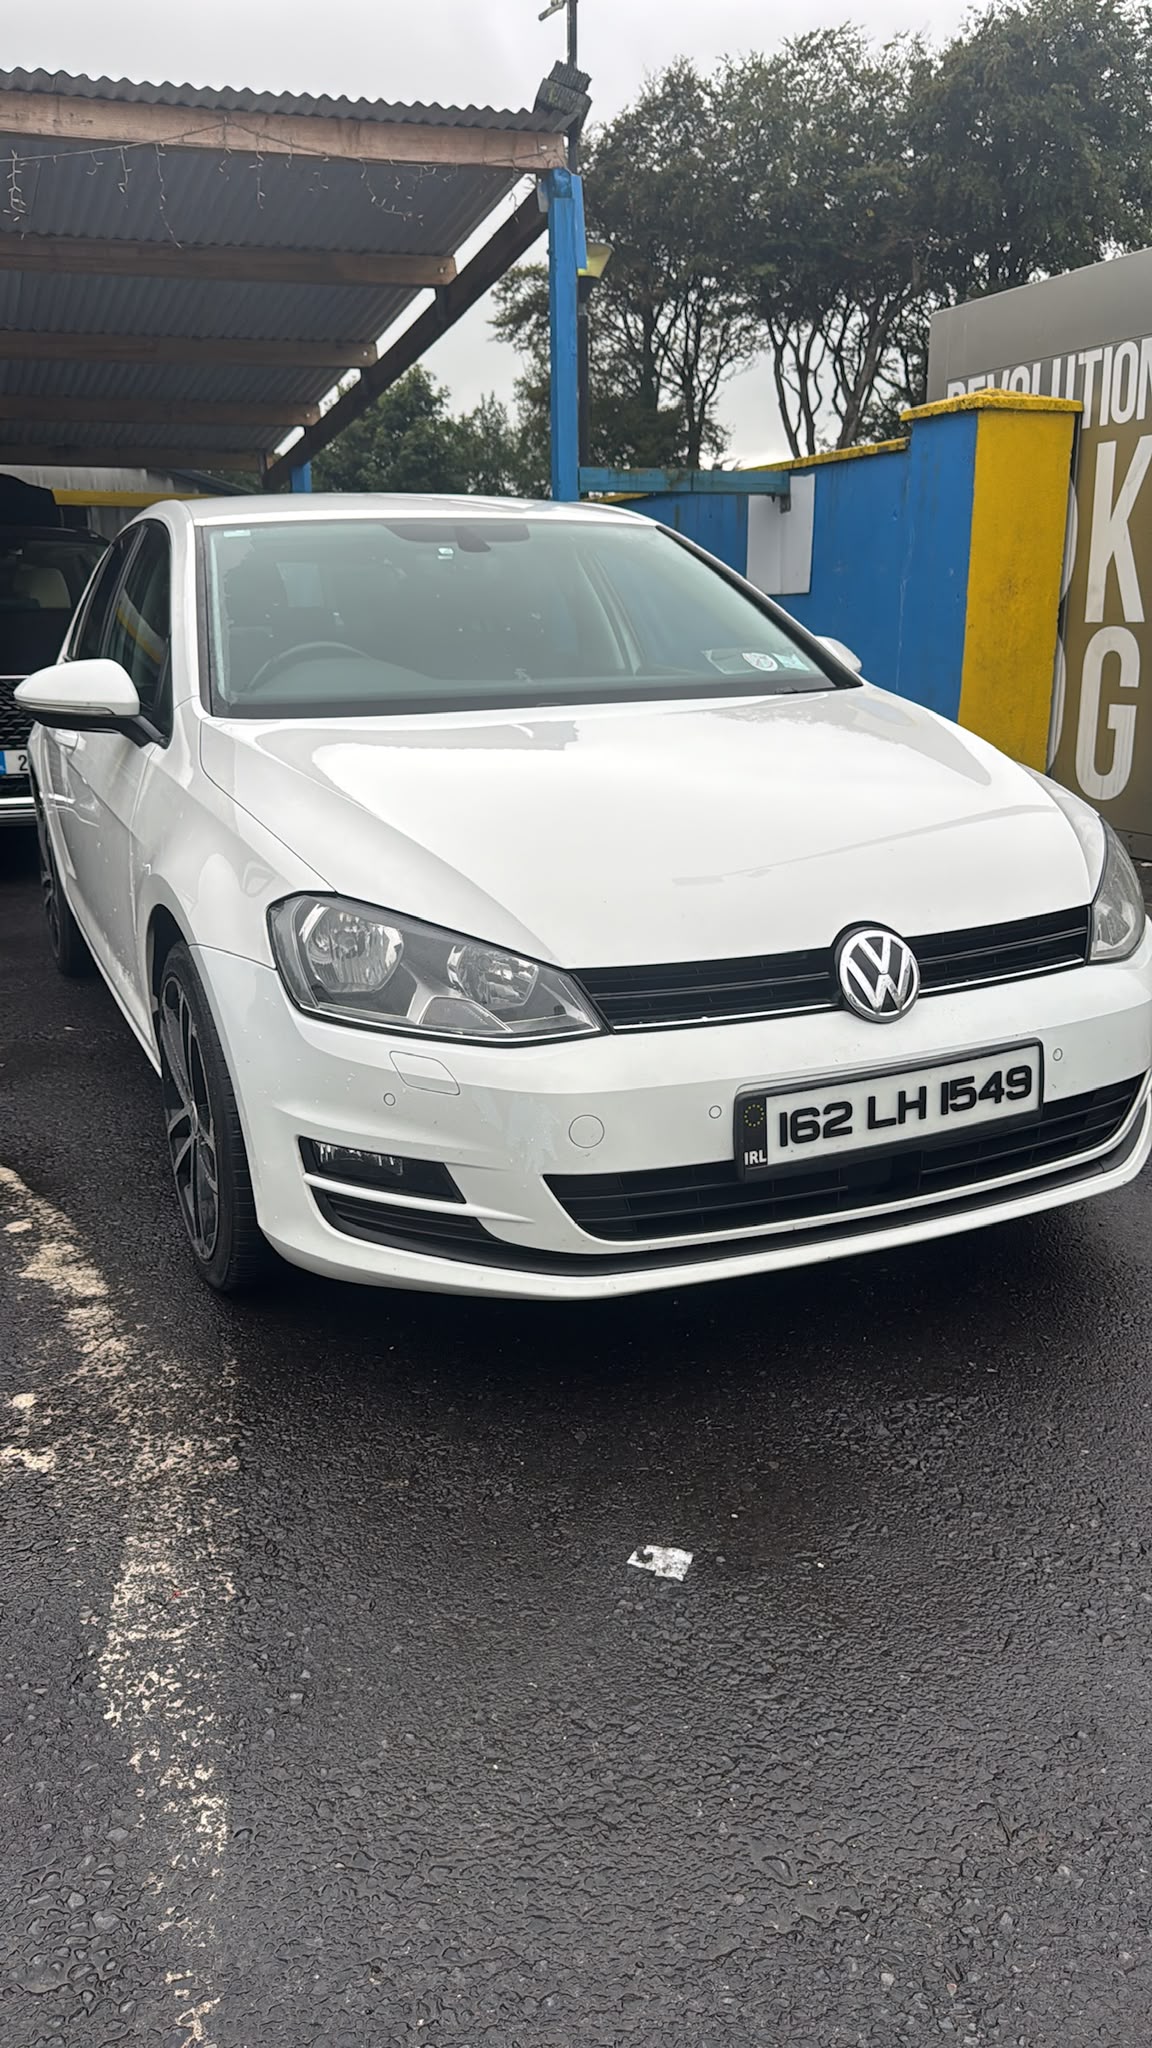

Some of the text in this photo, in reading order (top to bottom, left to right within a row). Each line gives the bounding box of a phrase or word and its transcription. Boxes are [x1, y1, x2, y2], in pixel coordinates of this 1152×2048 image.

[840, 929, 920, 1016] VW
[779, 1065, 1032, 1147] 162 LH 1549
[744, 1150, 767, 1165] IRL
